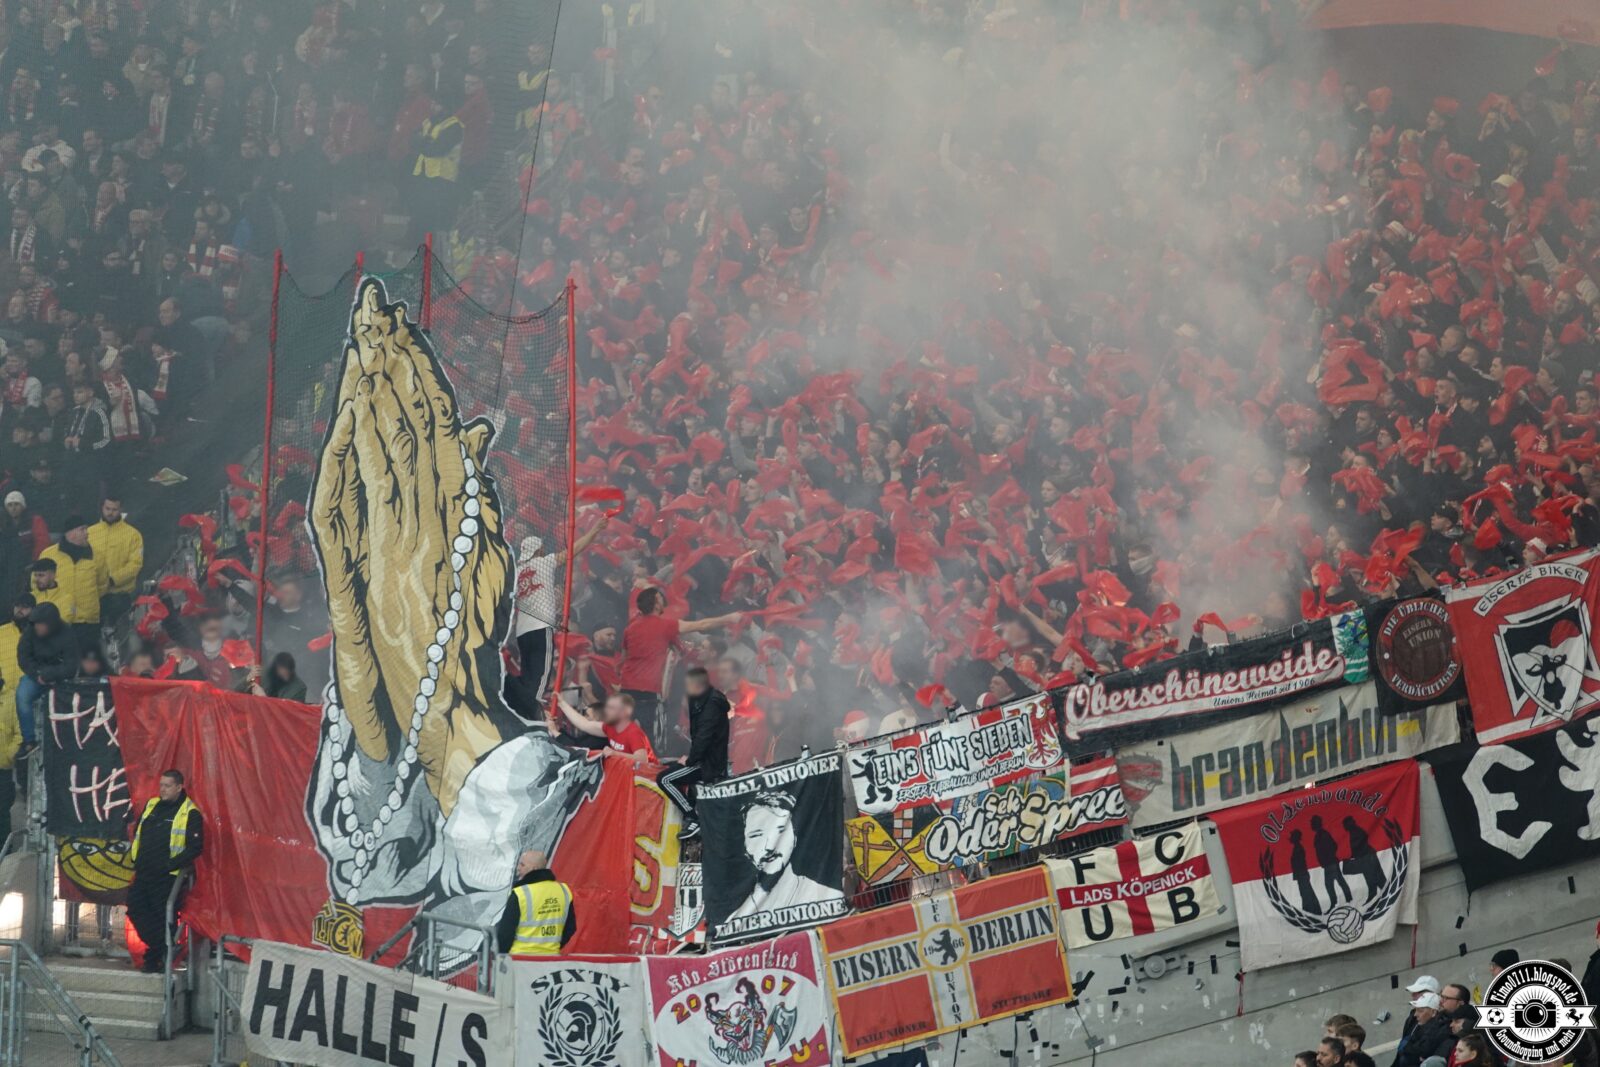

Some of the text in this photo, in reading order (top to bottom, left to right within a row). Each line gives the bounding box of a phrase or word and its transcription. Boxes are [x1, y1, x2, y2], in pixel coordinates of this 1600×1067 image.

[1538, 565, 1583, 581] BIKER
[1384, 601, 1450, 636] DIE ÜBLICHEN
[1408, 628, 1442, 648] UNION
[1065, 640, 1337, 723] Oberschöneweide
[1213, 696, 1245, 707] Unions
[48, 689, 120, 750] HA
[872, 713, 1033, 786] EINS FÜNF SIEBEN
[1170, 695, 1428, 812] brandenbur
[696, 755, 841, 801] EINMAL UNIONER
[1070, 866, 1198, 905] LADS KÖPENICK
[833, 905, 1055, 988] EISERN BERLIN
[531, 969, 632, 995] SIXTY
